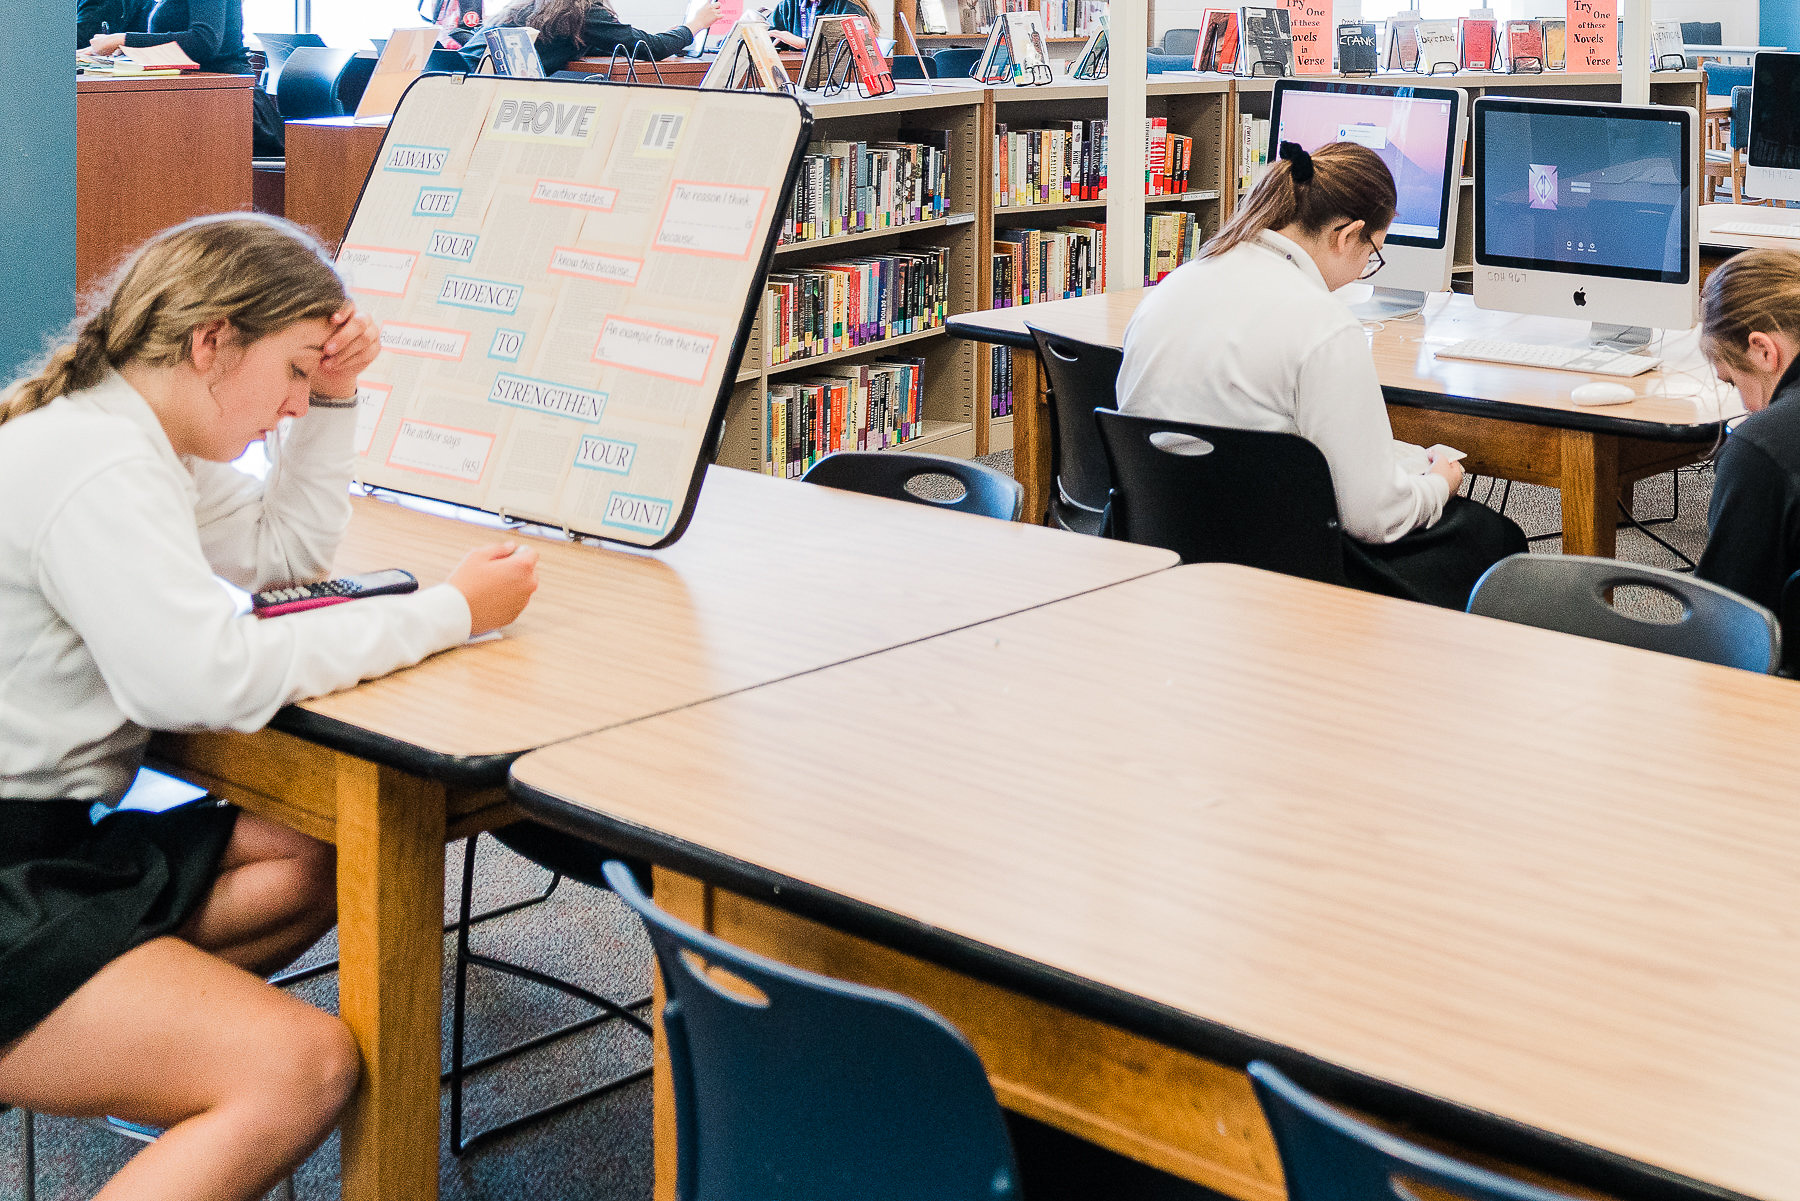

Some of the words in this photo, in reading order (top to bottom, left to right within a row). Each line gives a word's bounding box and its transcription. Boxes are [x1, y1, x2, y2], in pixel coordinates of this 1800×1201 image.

[1306, 8, 1326, 16] One
[1574, 0, 1593, 13] Try
[1292, 32, 1317, 42] ovels
[1574, 34, 1604, 43] Novels
[1589, 46, 1596, 54] in
[1297, 56, 1326, 66] Verse
[1585, 56, 1611, 66] Verse
[492, 100, 597, 138] PROVE
[642, 113, 684, 150] IT!
[389, 151, 444, 170] ALWAYS
[1150, 142, 1165, 174] KING
[537, 184, 551, 197] The
[552, 187, 577, 201] author
[676, 187, 690, 199] The
[691, 190, 721, 203] reason
[420, 193, 454, 212] CITE
[433, 235, 473, 257] YOUR
[561, 255, 579, 270] know
[580, 257, 595, 271] this
[1508, 272, 1527, 283] 967
[442, 280, 518, 308] EVIDENCE
[402, 335, 412, 346] on
[412, 336, 431, 350] what
[498, 332, 519, 354] TO
[605, 322, 619, 336] An
[620, 326, 653, 344] example
[653, 331, 675, 347] from
[676, 337, 691, 351] the
[692, 341, 711, 356] text
[493, 378, 603, 418] STRENGTHEN
[402, 423, 416, 436] The
[416, 426, 441, 442] author
[442, 435, 462, 448] says
[583, 440, 630, 468] YOUR
[610, 497, 667, 526] POINT
